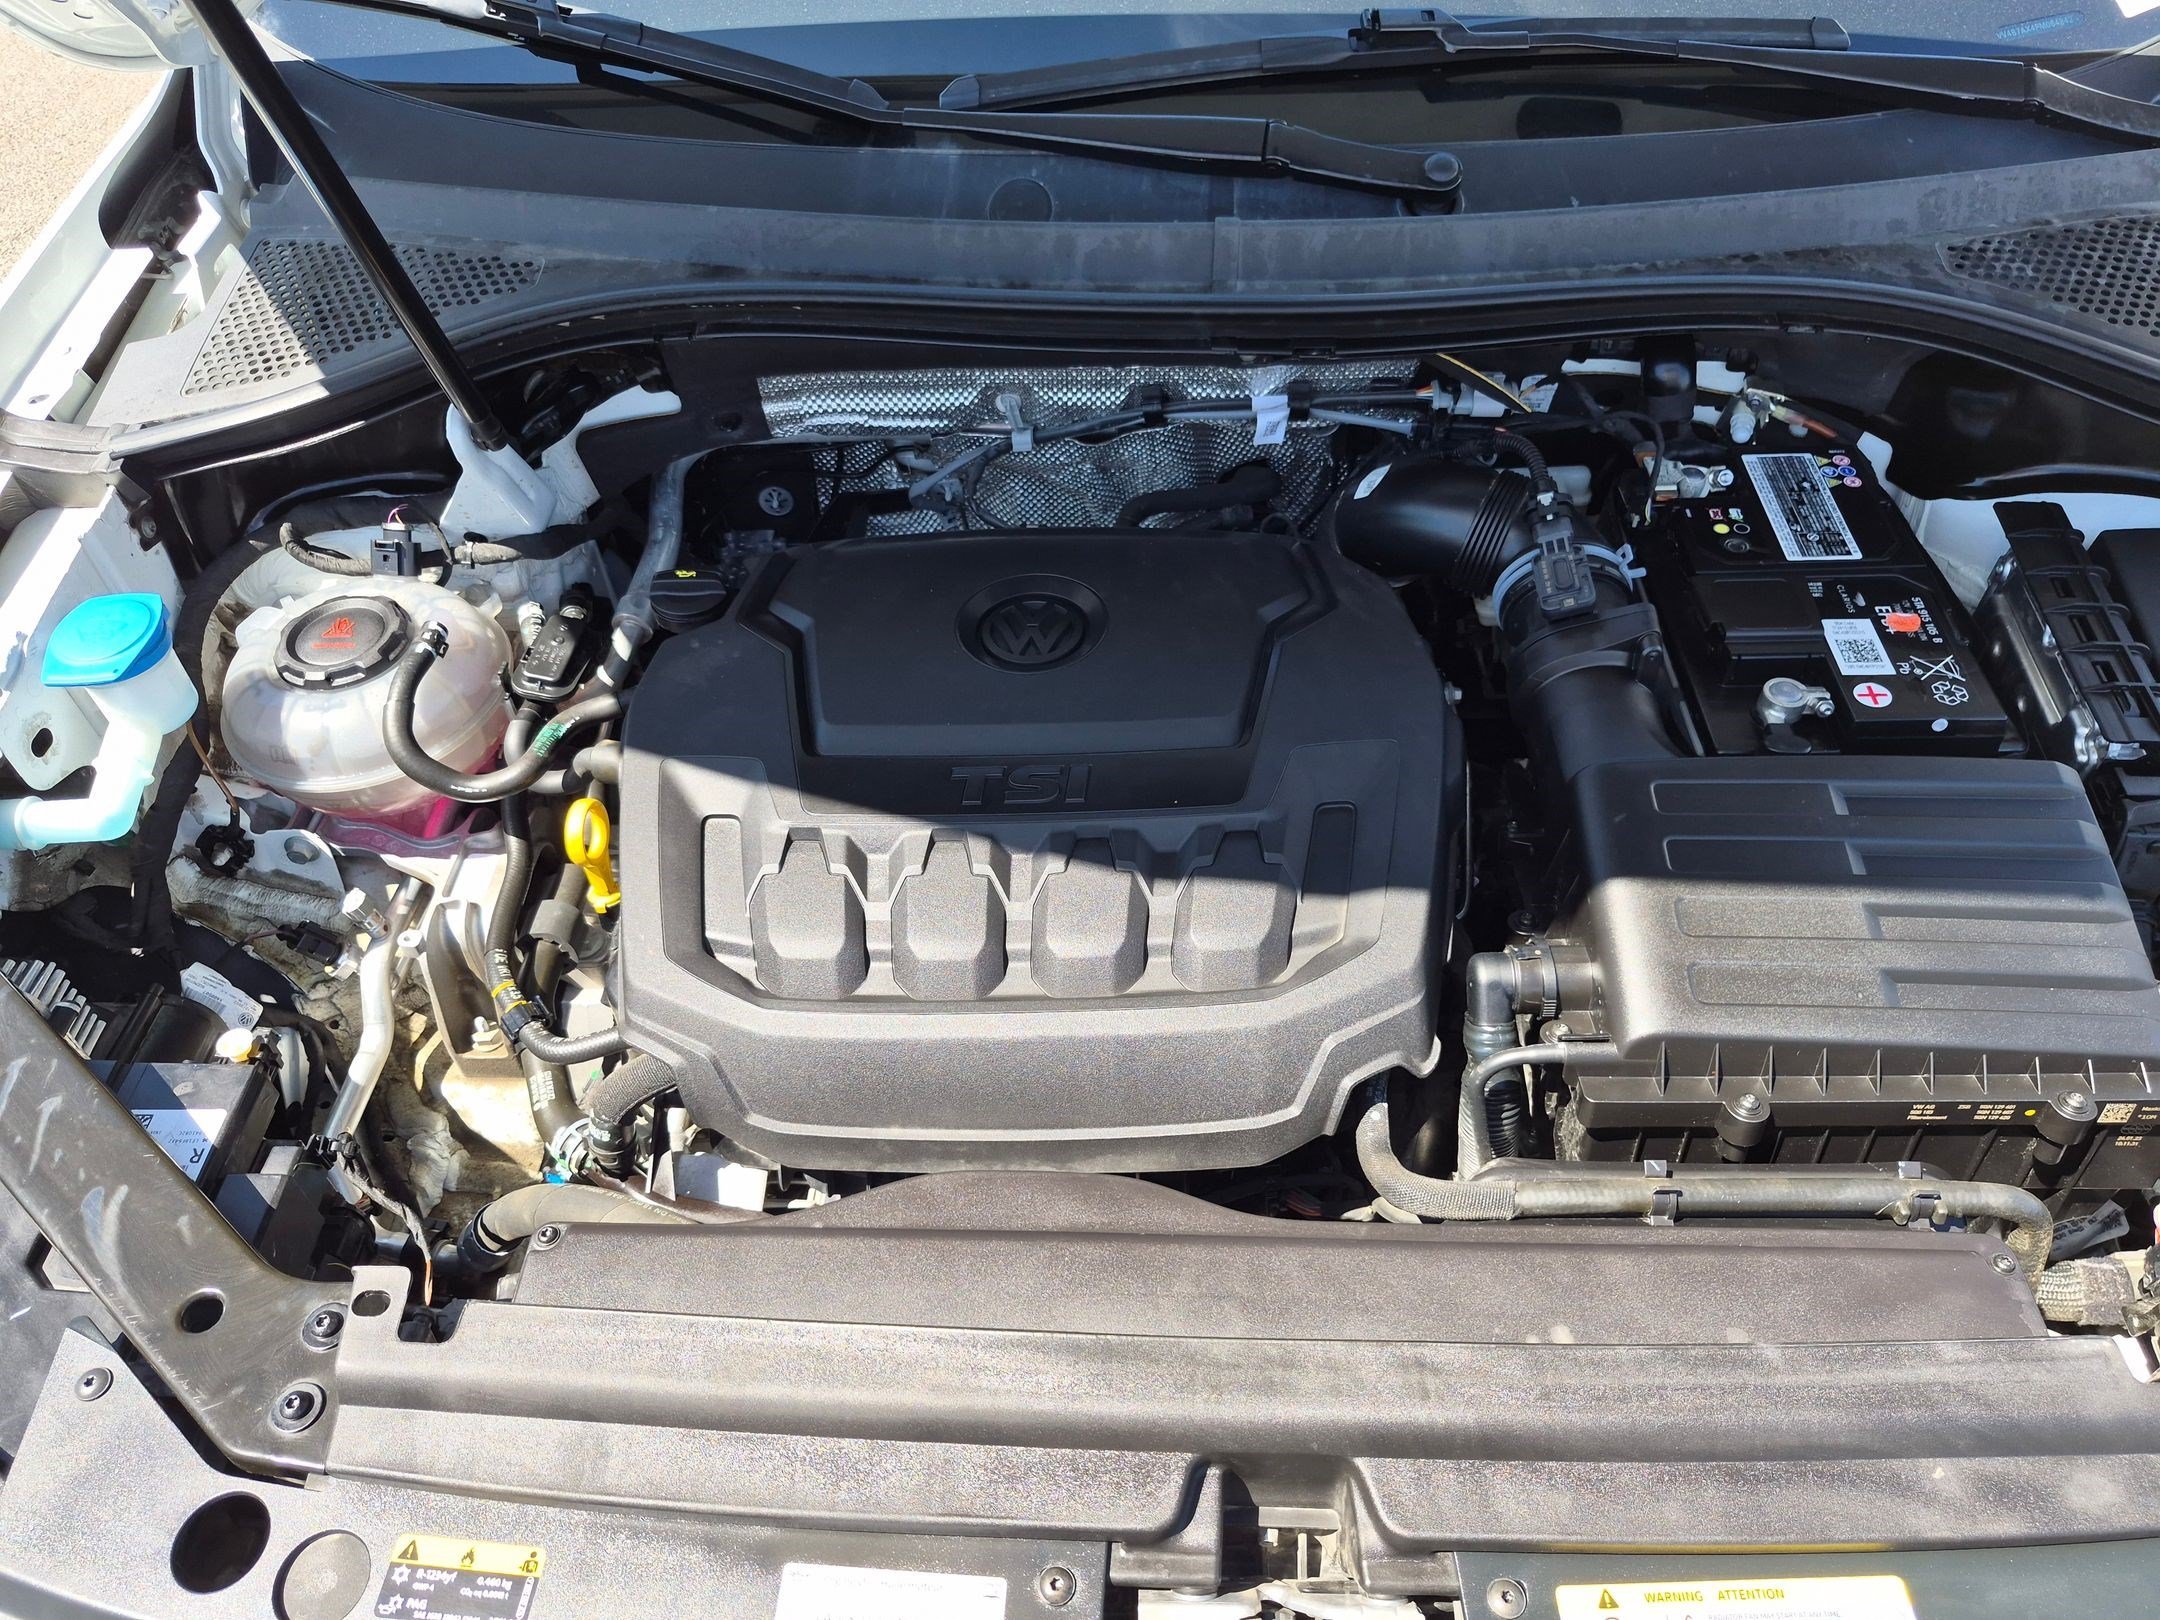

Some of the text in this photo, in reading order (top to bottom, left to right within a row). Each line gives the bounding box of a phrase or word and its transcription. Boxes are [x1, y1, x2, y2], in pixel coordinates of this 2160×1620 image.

[1837, 584, 1856, 613] CLARIOS
[1918, 609, 1932, 623] 915
[1896, 662, 1911, 675] Pb
[952, 763, 1093, 806] TSI
[189, 1148, 205, 1163] R
[1644, 1588, 1785, 1603] WARNING ATTENTION
